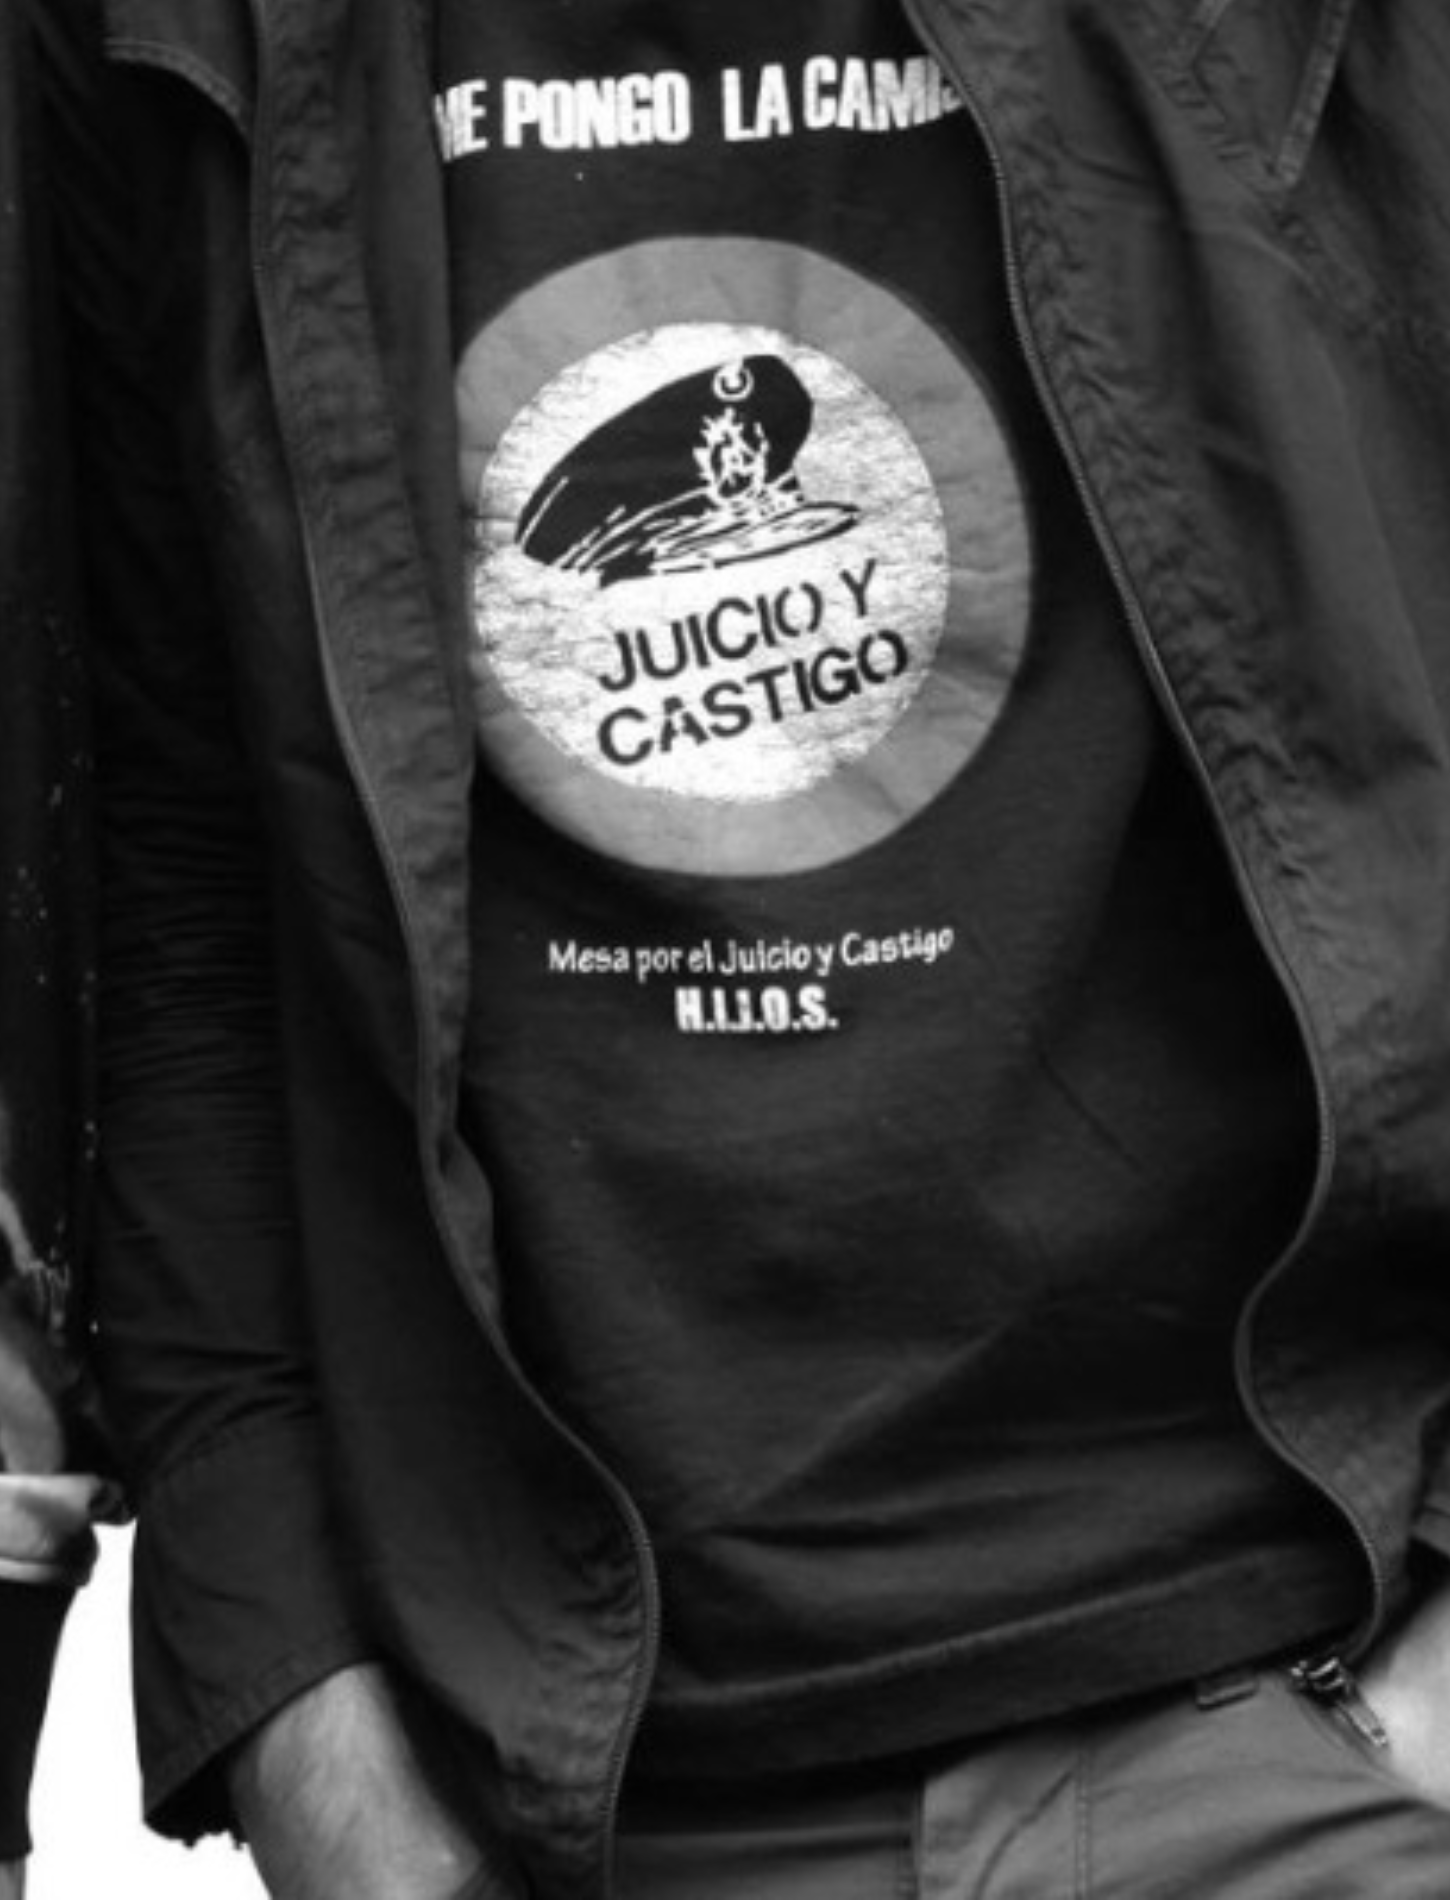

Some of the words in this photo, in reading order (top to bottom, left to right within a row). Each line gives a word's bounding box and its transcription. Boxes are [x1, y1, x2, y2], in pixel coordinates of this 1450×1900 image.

[503, 75, 692, 150] PONGO
[722, 64, 792, 141] LA
[597, 581, 824, 693] JUICIO
[841, 559, 879, 616] Y
[598, 629, 910, 766] CASTIGO
[549, 941, 630, 974] Mesa
[636, 947, 684, 983] por
[688, 941, 714, 973] el
[719, 937, 811, 976] Juicio
[816, 942, 834, 977] y
[841, 929, 955, 967] Castigo
[674, 984, 840, 1032] H.I.J.O.S.
